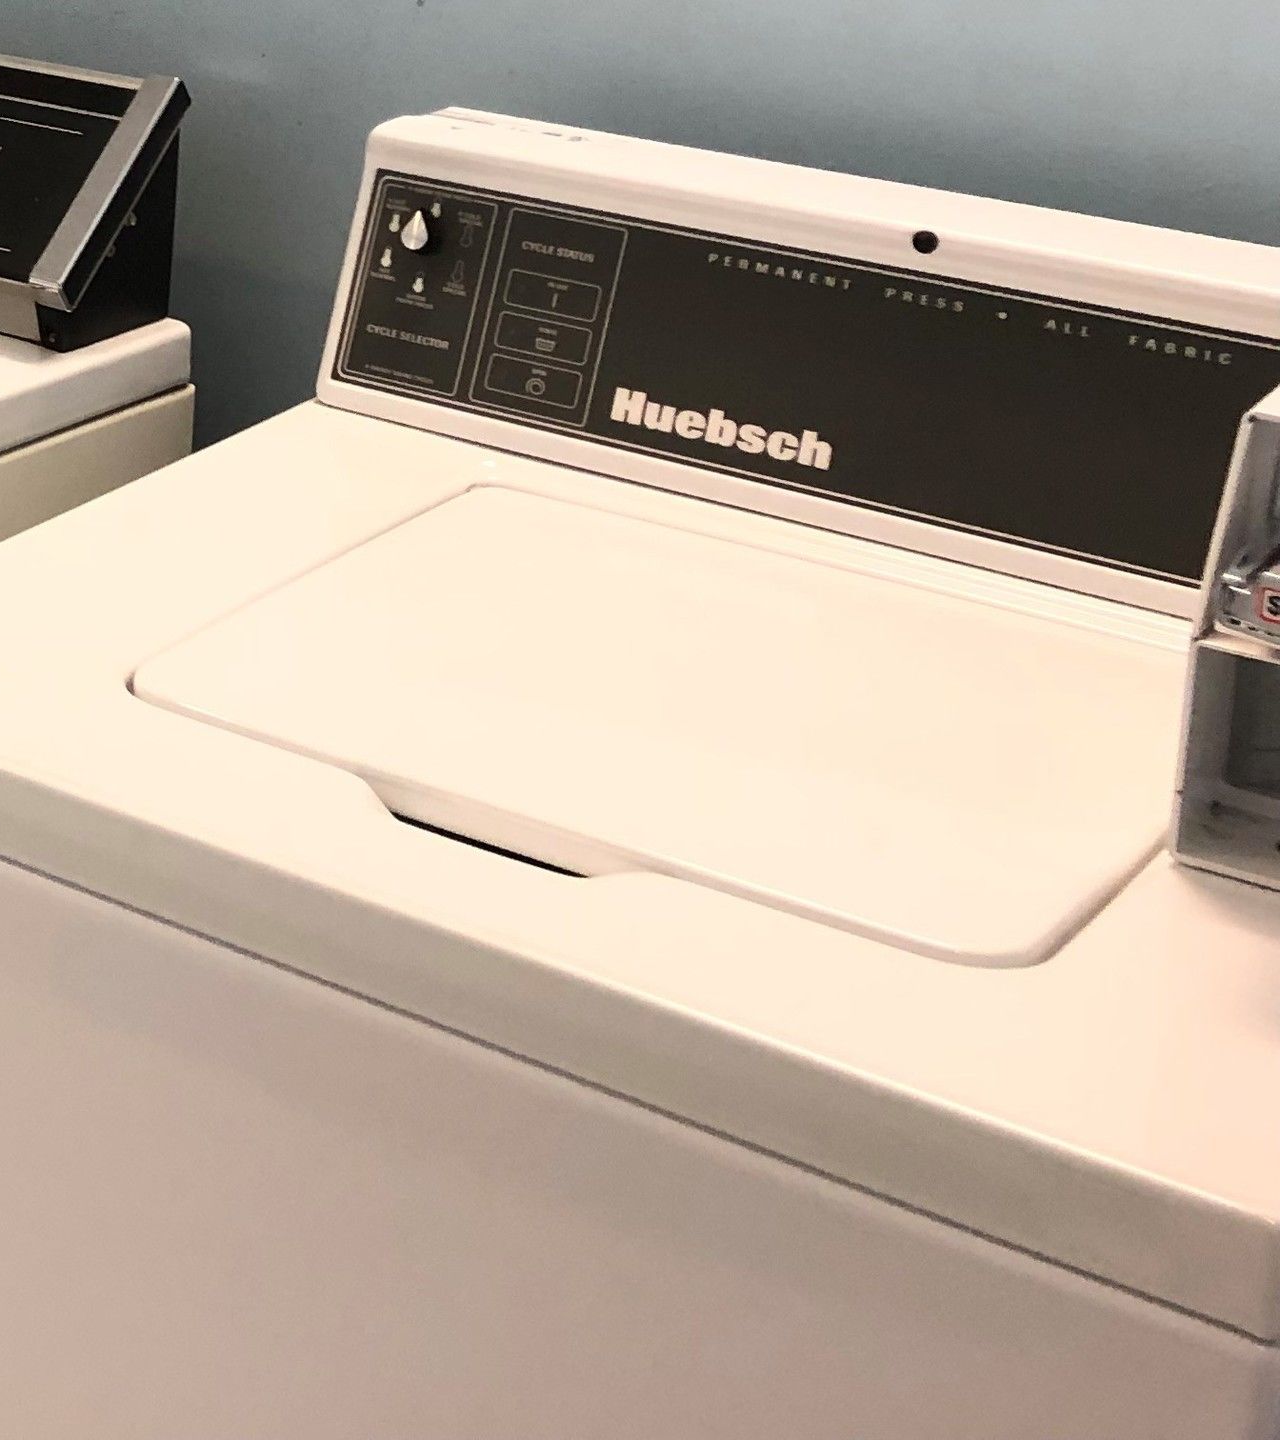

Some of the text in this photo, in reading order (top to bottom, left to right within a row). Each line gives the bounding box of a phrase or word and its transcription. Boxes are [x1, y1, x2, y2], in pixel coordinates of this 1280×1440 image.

[521, 240, 555, 256] CYCLE
[707, 252, 1233, 365] PERMANENT PRESS ALL FABRIC
[366, 323, 450, 351] CYCLE SELECTOR
[609, 386, 834, 471] Huebsch
